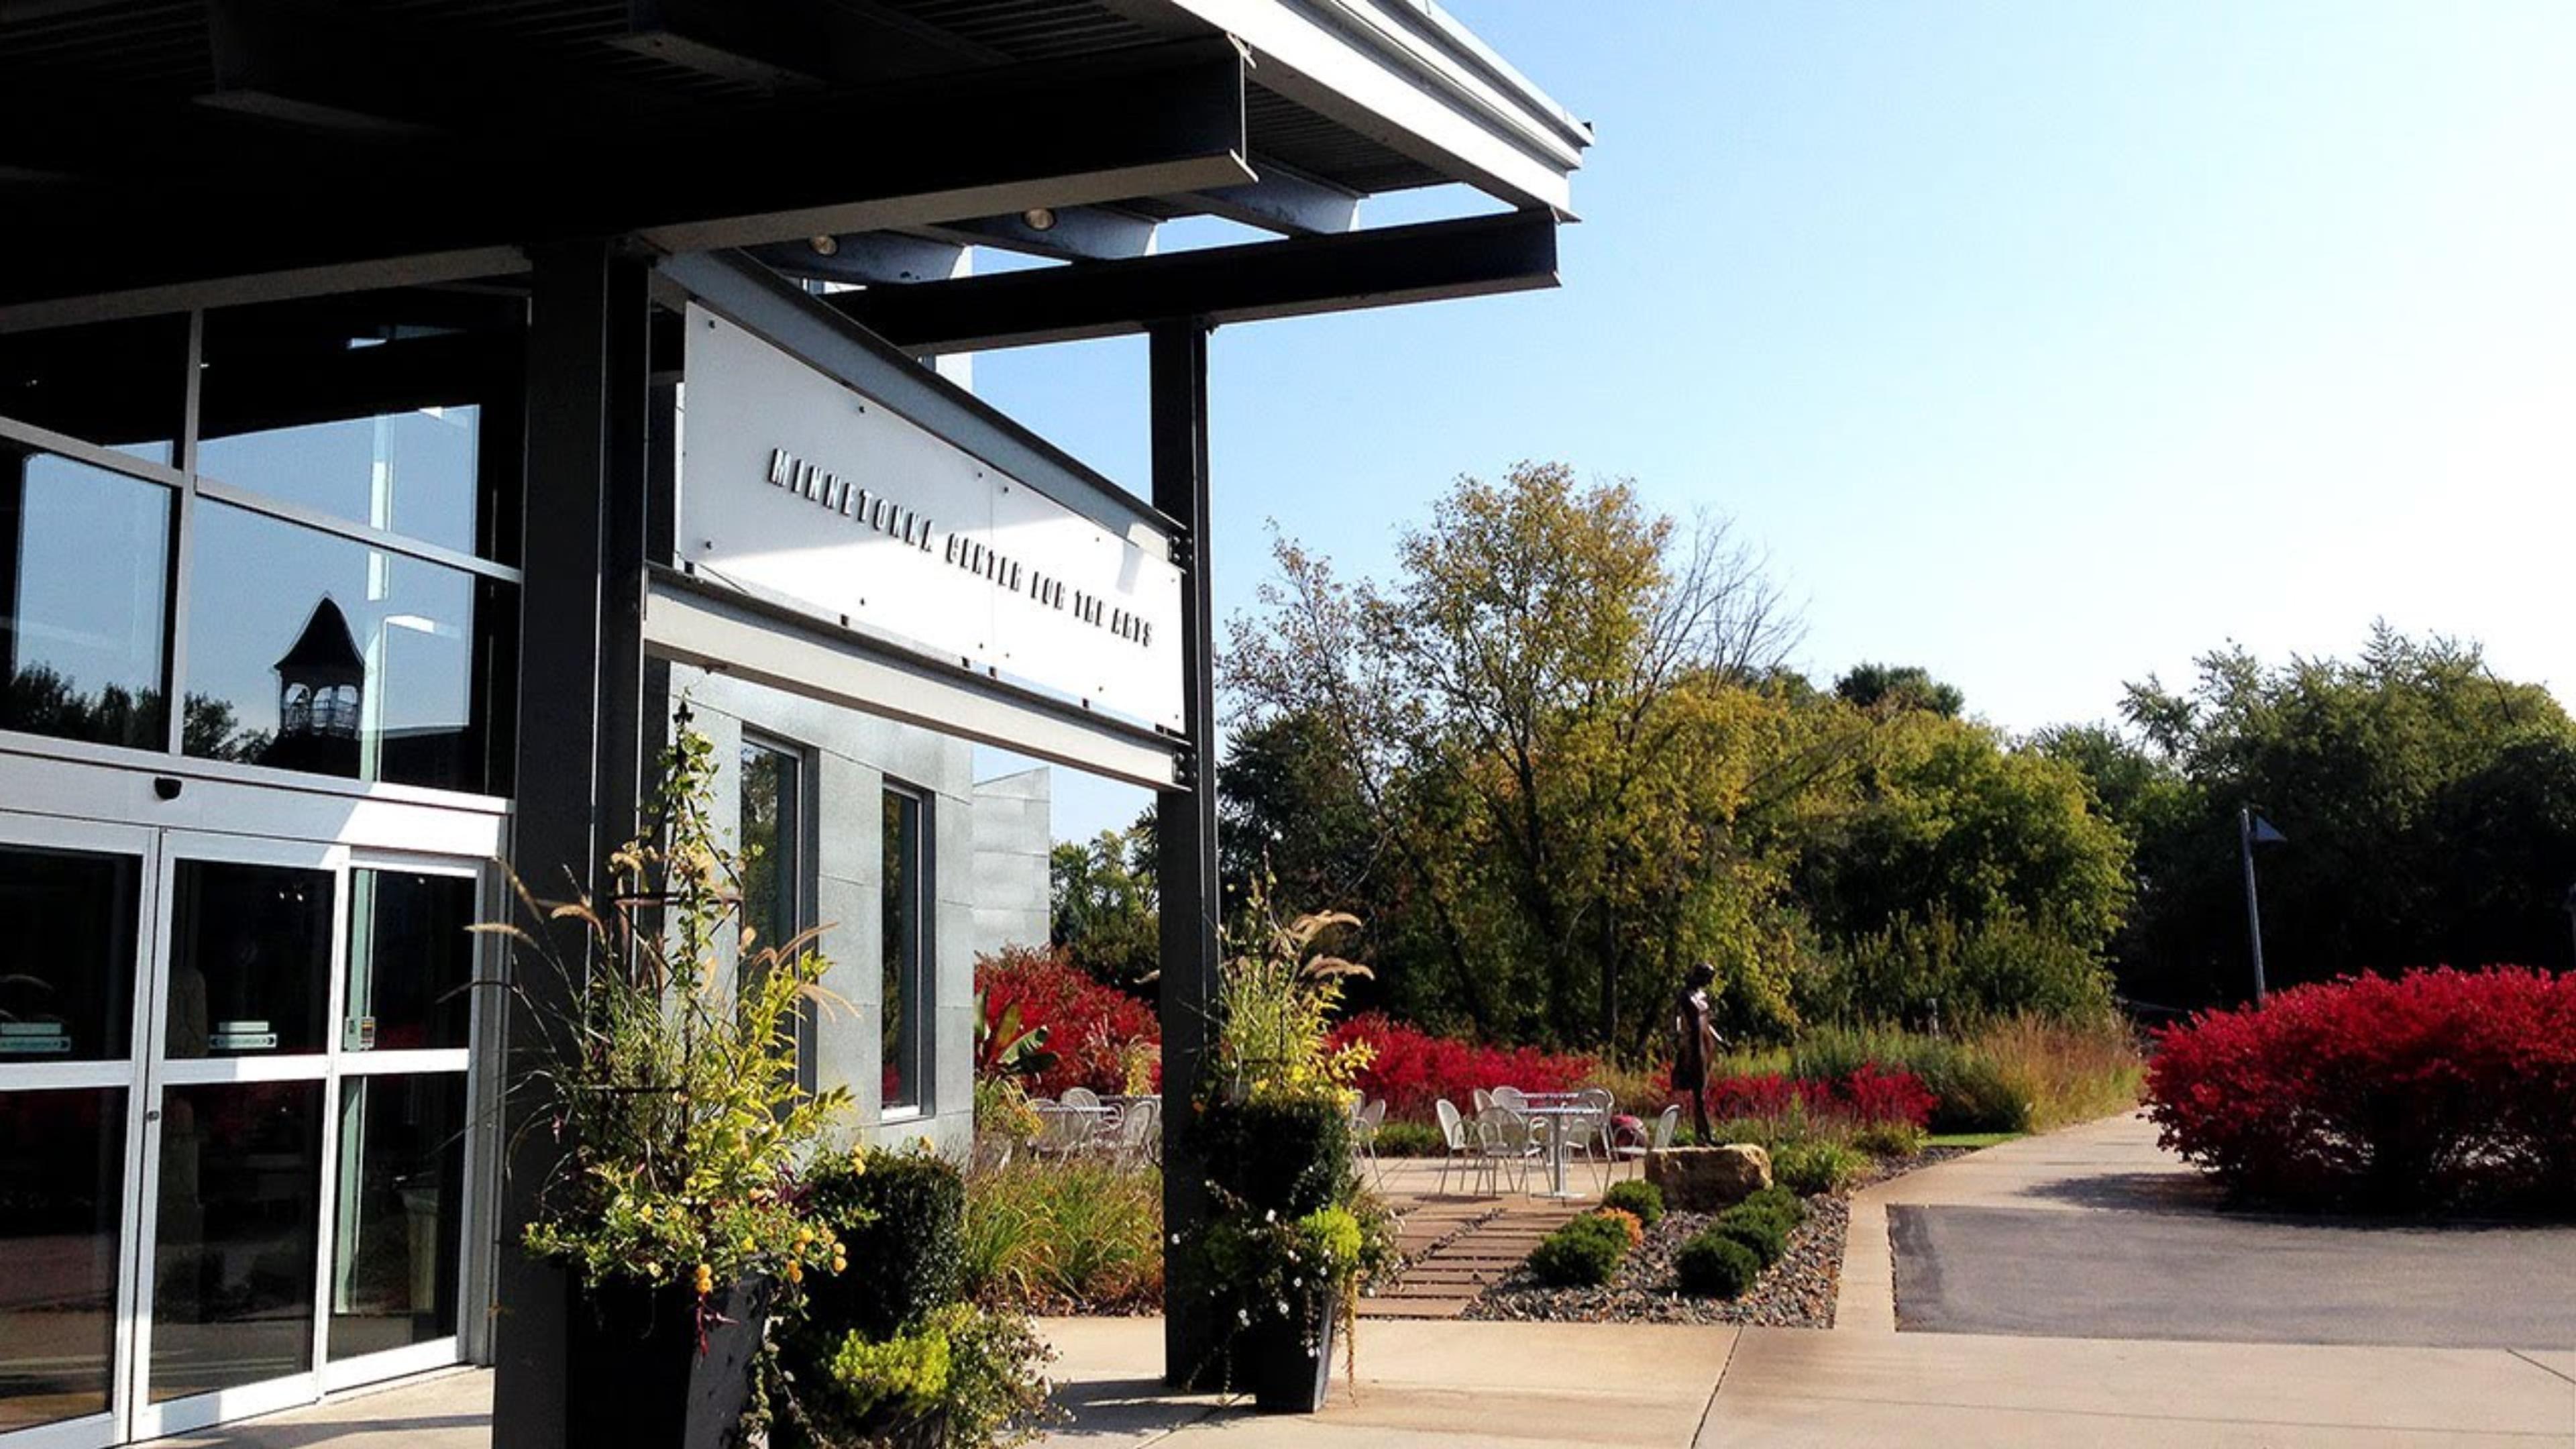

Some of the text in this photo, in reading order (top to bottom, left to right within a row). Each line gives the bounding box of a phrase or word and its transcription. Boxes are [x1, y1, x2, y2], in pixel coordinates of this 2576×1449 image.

[768, 447, 1152, 647] MINNETONKA CENTER FOR THE ARTS
